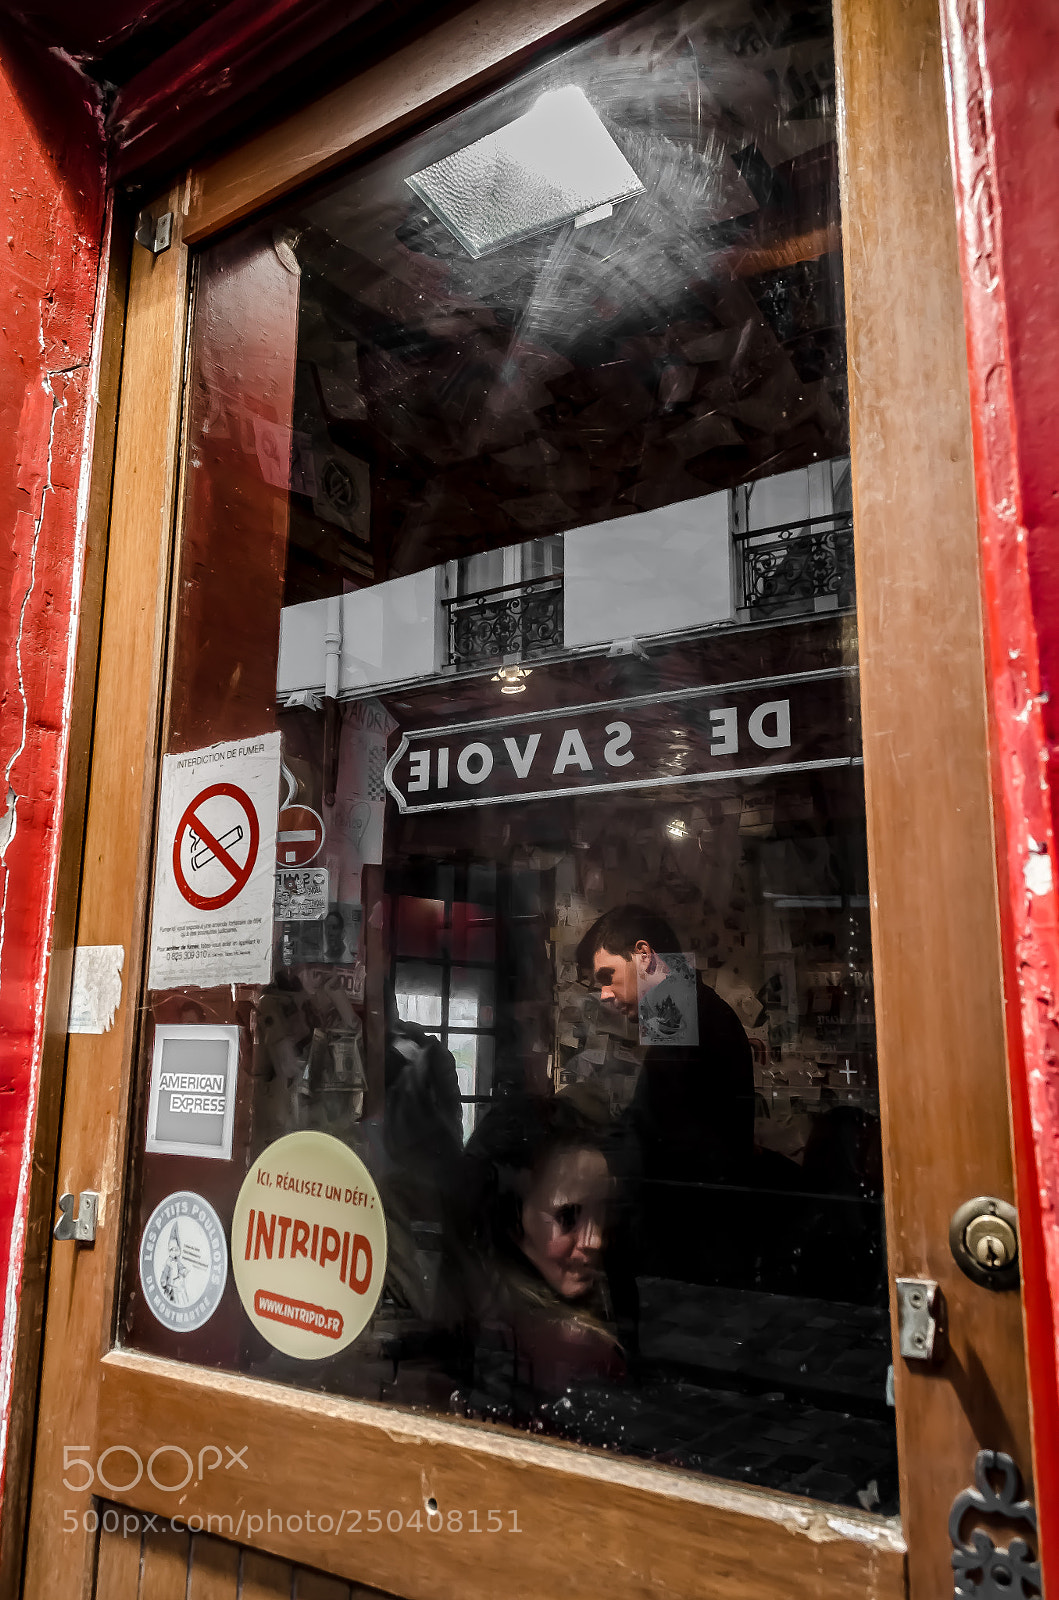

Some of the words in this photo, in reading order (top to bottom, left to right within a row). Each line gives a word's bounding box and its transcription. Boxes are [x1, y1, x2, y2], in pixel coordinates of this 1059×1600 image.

[177, 751, 225, 769] INTERDICTION
[226, 748, 237, 760] DE
[238, 743, 265, 757] FUMER
[159, 1074, 223, 1092] AMERICAN
[171, 1095, 225, 1112] EXPRESS
[256, 1168, 272, 1188] ICI,
[276, 1171, 323, 1198] RÉALISEZ
[325, 1184, 341, 1202] UN
[344, 1186, 368, 1207] DÉFI
[244, 1208, 373, 1295] INTRIPID
[259, 1297, 341, 1332] WWW.INTRIPID.FR
